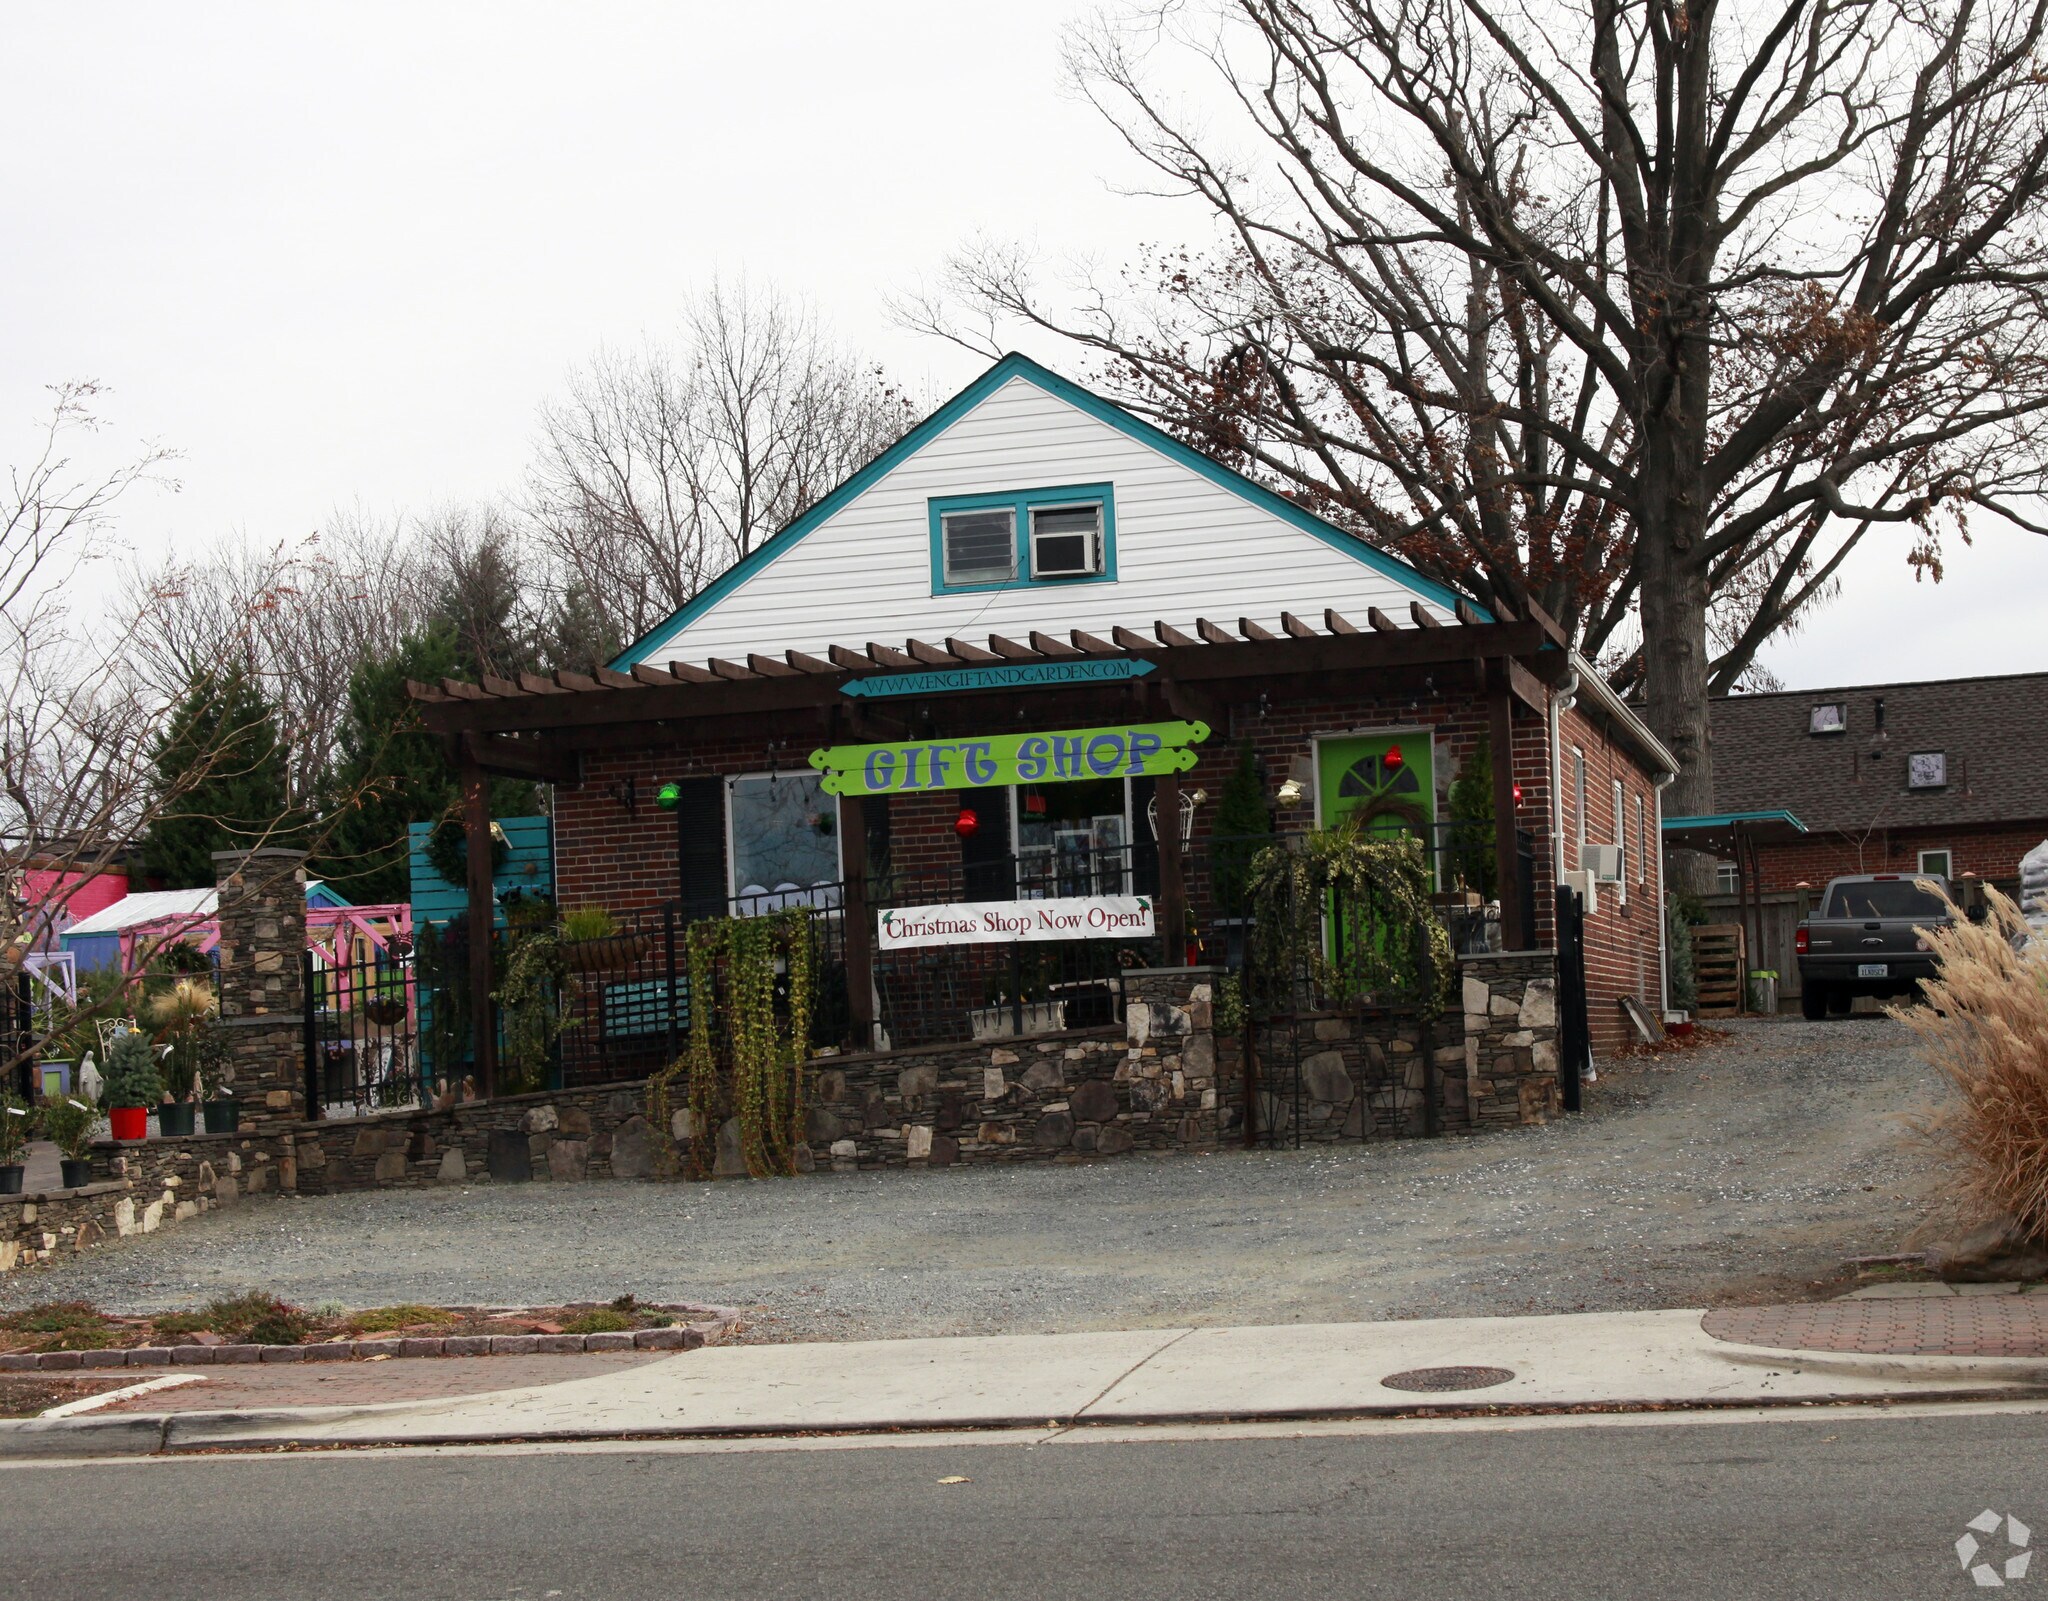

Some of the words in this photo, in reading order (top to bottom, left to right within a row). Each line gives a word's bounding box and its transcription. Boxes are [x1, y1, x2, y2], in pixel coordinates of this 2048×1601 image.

[863, 742, 998, 791] GIFT
[1015, 730, 1162, 781] SHOP
[886, 915, 977, 939] Christmas
[983, 912, 1032, 936] Shop
[1037, 909, 1083, 930] Now
[1087, 907, 1147, 932] Open!
